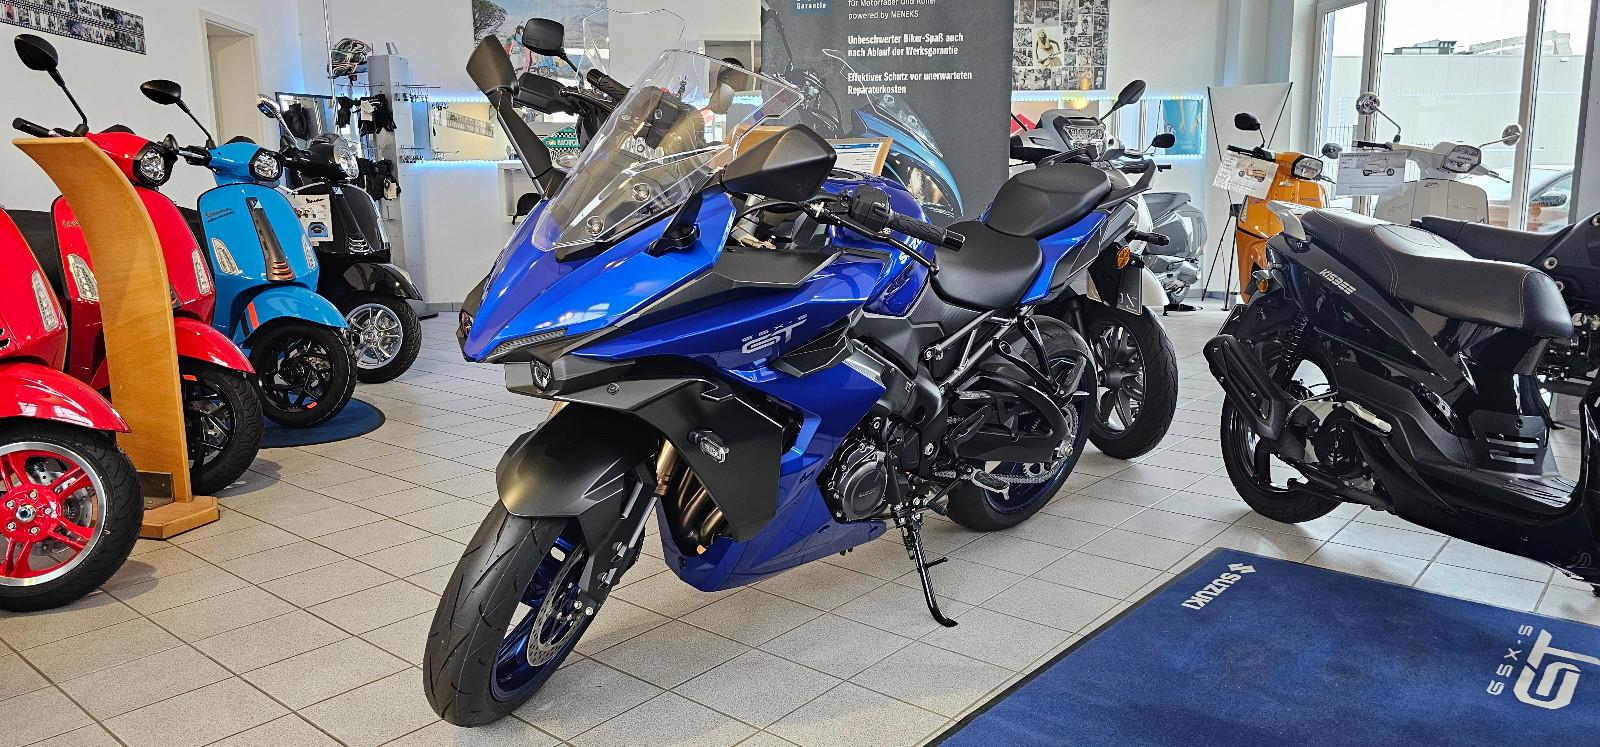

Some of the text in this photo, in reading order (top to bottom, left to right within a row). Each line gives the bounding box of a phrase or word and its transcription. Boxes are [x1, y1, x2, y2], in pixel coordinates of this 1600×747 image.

[796, 2, 827, 10] Garantie
[848, 10, 919, 20] powered by MENEKS
[848, 32, 964, 45] Unbeschwerter Biker-Spaß auch
[848, 45, 959, 57] nach Ablauf der Werksgarantie
[847, 71, 973, 82] Effektiver Schutz vor unerwarteten
[847, 84, 907, 97] Reparaturkosten
[741, 318, 808, 354] GT
[1180, 572, 1242, 610] SUZUKI
[1513, 628, 1600, 710] GT
